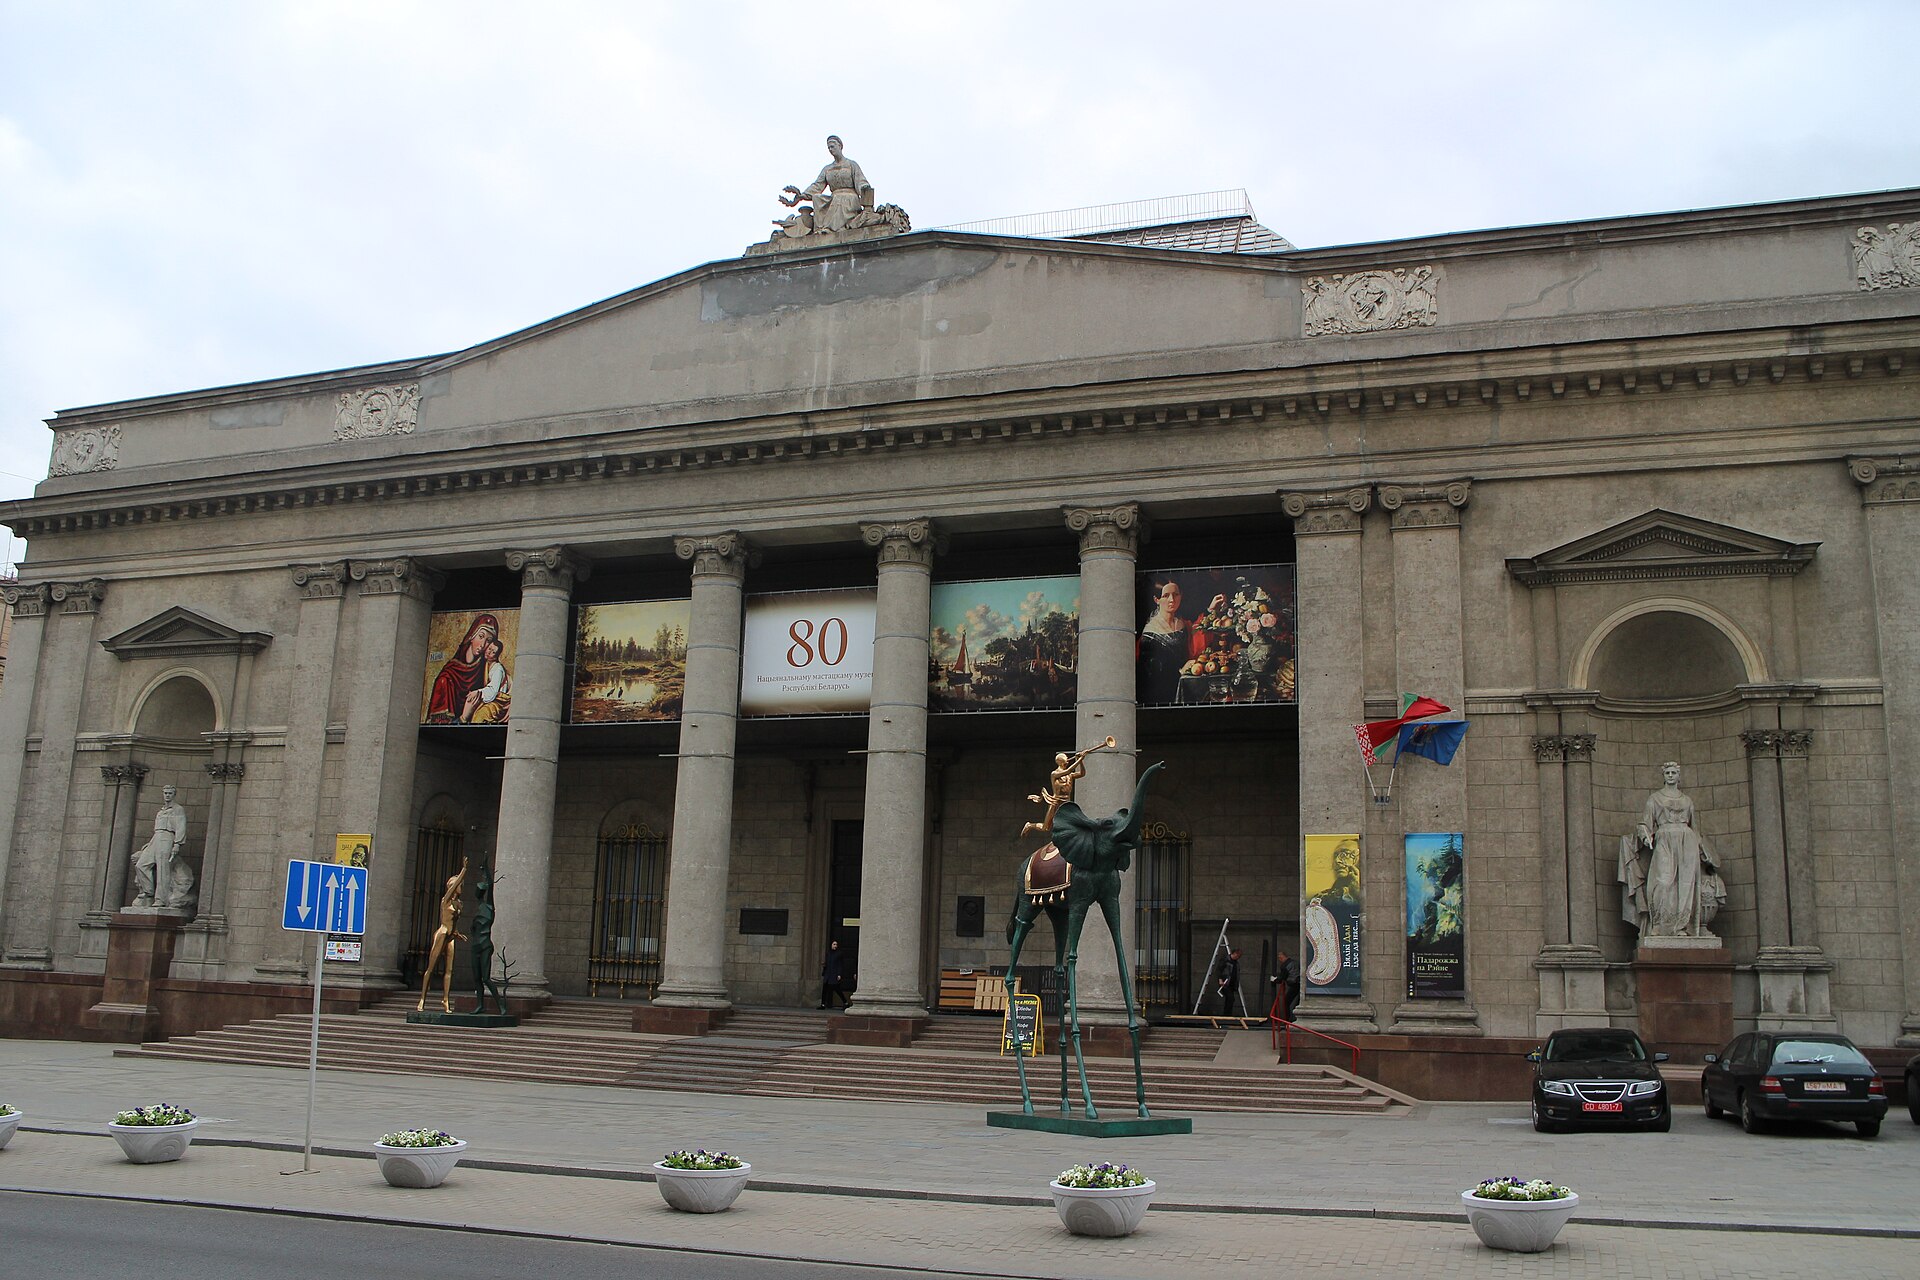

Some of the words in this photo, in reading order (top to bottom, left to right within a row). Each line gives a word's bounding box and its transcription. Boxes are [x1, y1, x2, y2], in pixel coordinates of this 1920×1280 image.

[786, 617, 848, 668] 80
[757, 674, 811, 683] Нацыянальнаму
[813, 672, 853, 681] мастацкаму
[782, 684, 817, 693] Рэспублікі
[818, 682, 850, 691] Беларусь
[1342, 925, 1351, 943] Далі
[1352, 942, 1359, 951] да
[1342, 944, 1351, 968] Вялікі
[1351, 952, 1359, 968] ідзе
[1417, 956, 1459, 965] Падарожжа
